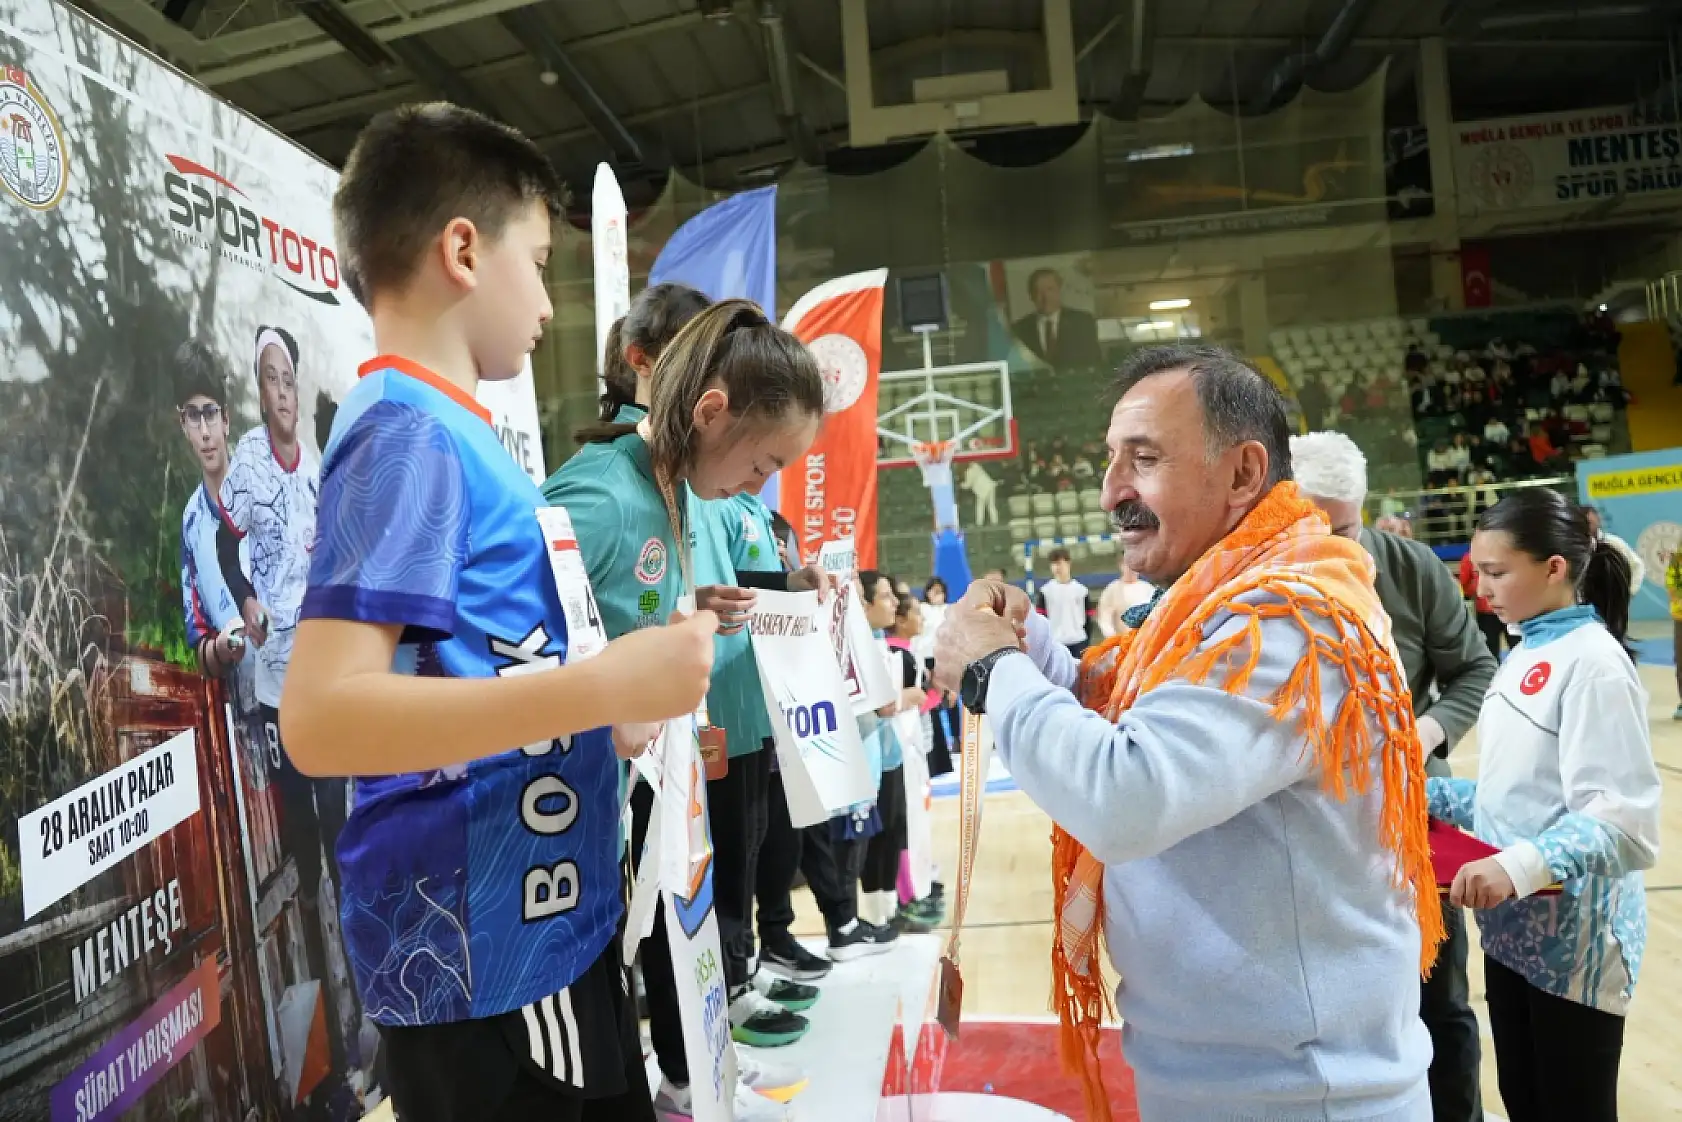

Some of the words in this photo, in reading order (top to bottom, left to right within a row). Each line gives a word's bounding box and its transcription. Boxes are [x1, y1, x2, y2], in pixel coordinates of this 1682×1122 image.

[1567, 128, 1682, 168] MENTEŞ
[1589, 115, 1623, 133] SPOR
[1556, 170, 1618, 200] SPOR
[804, 453, 825, 510] SPOR
[804, 514, 824, 543] VE
[40, 809, 62, 859] 28
[68, 774, 127, 846] ARALIK
[128, 751, 175, 803] PAZAR
[88, 826, 116, 866] SAAT
[119, 809, 149, 848] 10:00
[71, 878, 182, 1005] MENTEŞE
[74, 1052, 128, 1122] SÜRAT
[126, 986, 202, 1087] YARIŞMASI
